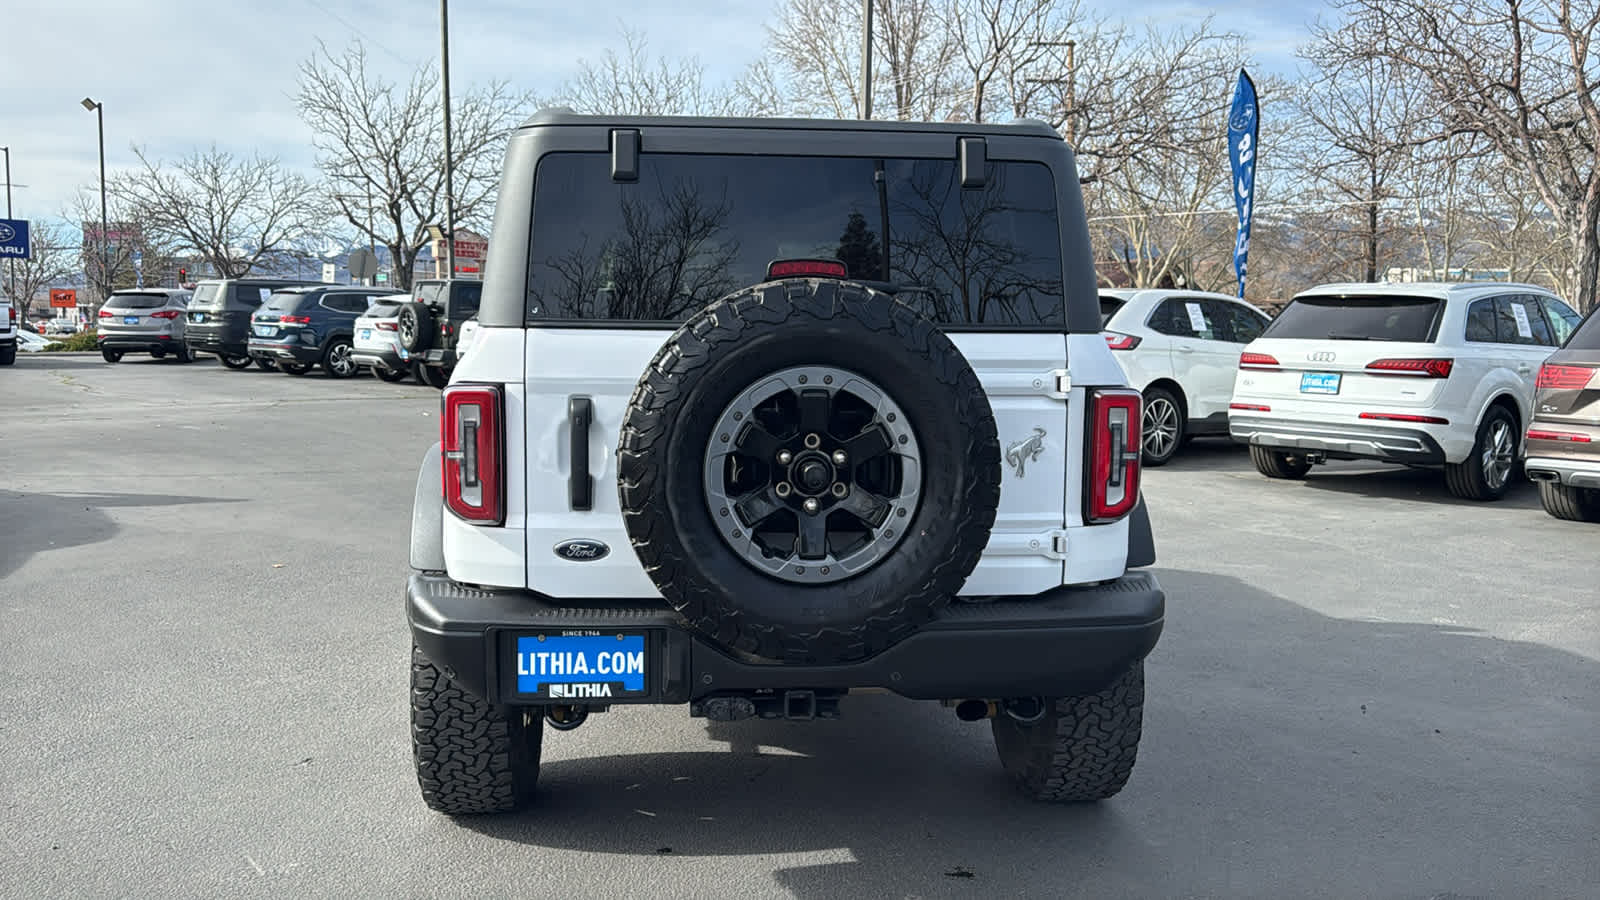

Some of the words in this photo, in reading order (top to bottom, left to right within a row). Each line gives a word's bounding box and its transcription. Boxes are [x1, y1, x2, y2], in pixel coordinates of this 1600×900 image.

[566, 543, 597, 557] Ford
[517, 651, 644, 676] LITHIA.COM
[563, 683, 612, 698] LITHIA
